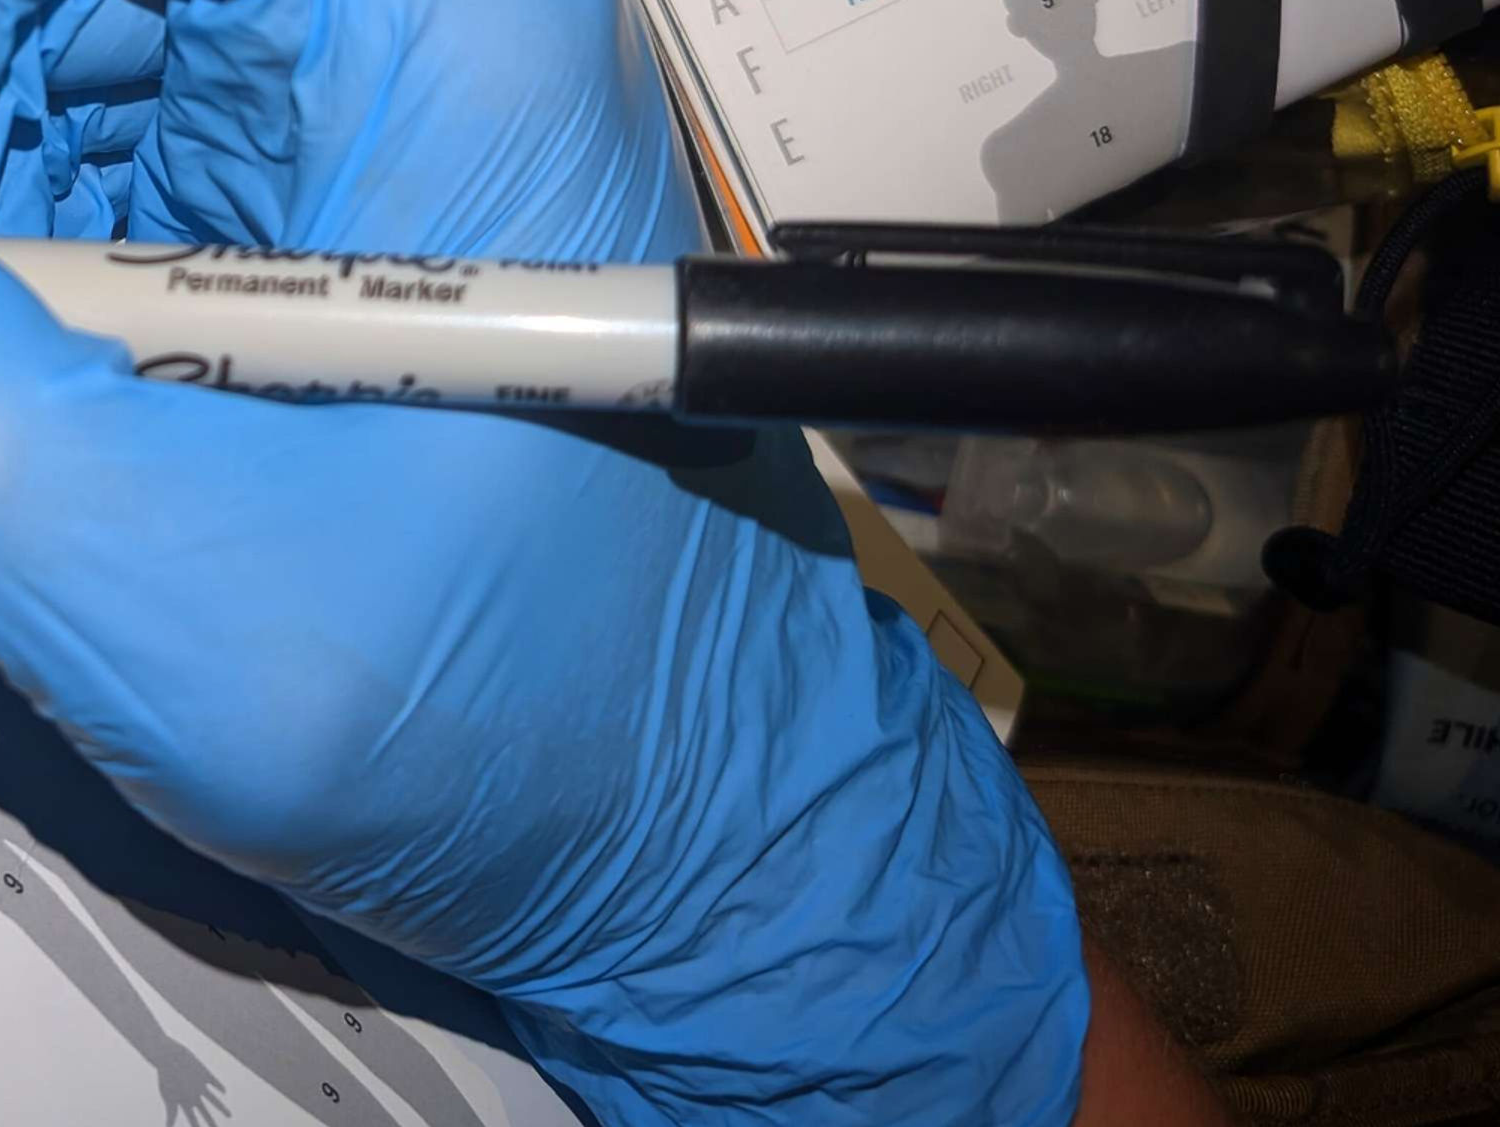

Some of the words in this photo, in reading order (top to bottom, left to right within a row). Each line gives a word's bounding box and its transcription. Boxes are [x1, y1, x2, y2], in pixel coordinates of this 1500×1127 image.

[958, 63, 1015, 104] RIGHT
[1090, 125, 1113, 148] 18
[167, 268, 330, 298] Permanent
[360, 275, 467, 304] Marker
[3, 872, 25, 894] 9
[344, 1012, 363, 1033] 9
[321, 1082, 341, 1103] 9
